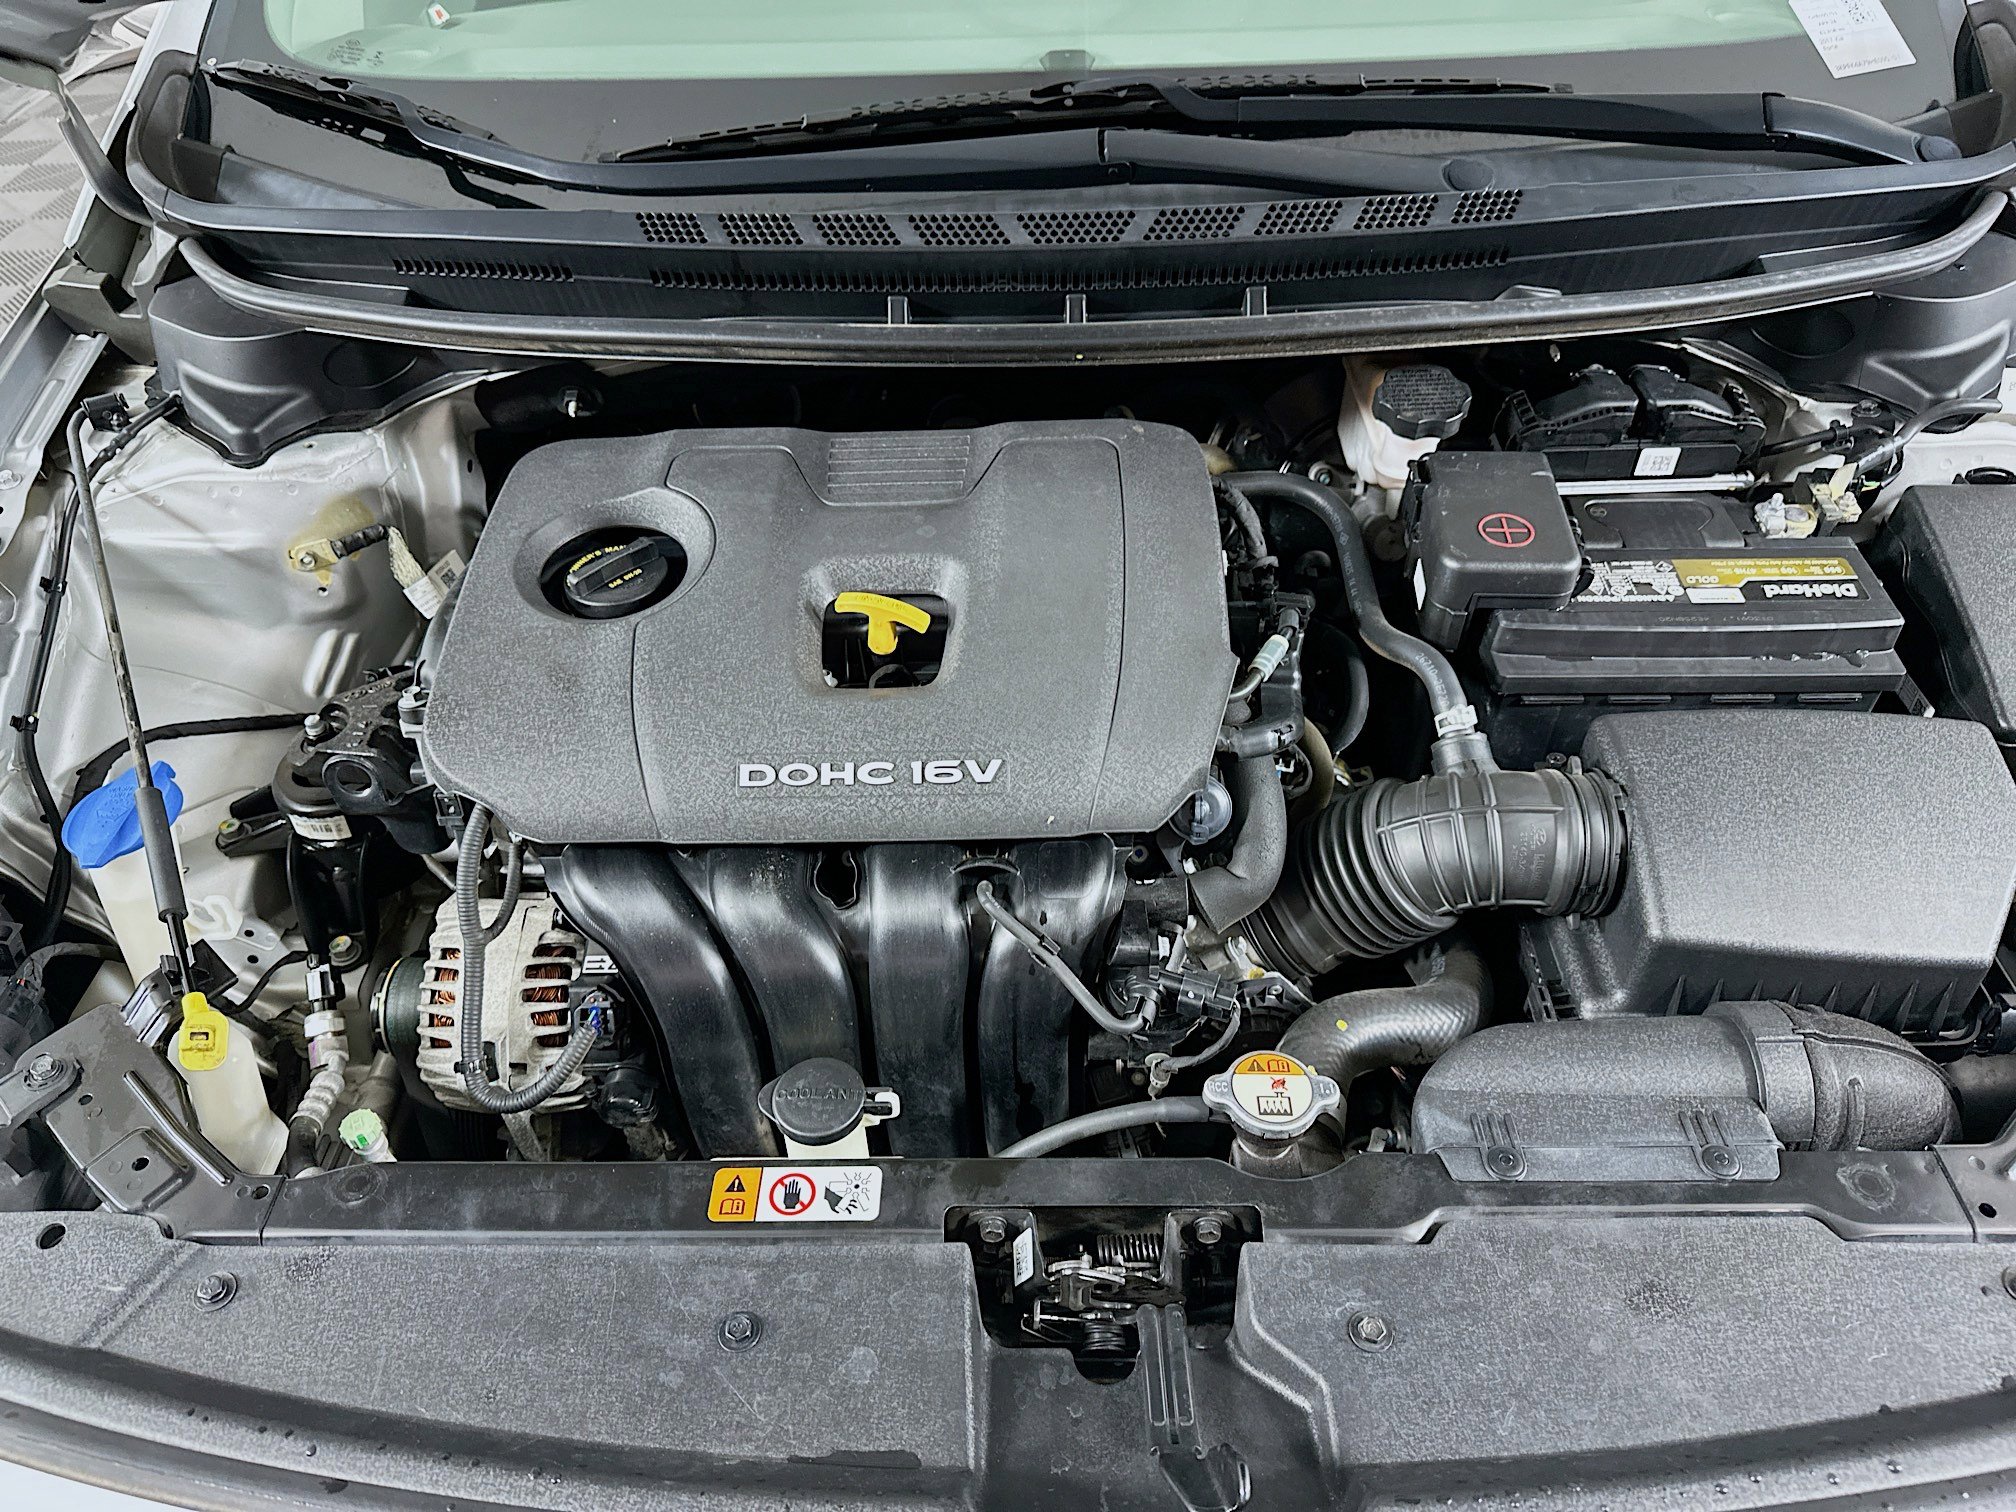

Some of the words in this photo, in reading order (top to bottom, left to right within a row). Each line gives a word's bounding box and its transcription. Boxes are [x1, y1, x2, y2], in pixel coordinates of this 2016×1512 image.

[569, 549, 603, 573] WNER'S
[608, 578, 623, 589] SAE
[1685, 575, 1720, 584] GOLD
[1763, 583, 1859, 598] DieHard
[738, 761, 896, 788] DOHC
[909, 758, 1003, 786] 16V
[775, 1087, 861, 1101] COOLANT
[1319, 1083, 1335, 1094] 1.1
